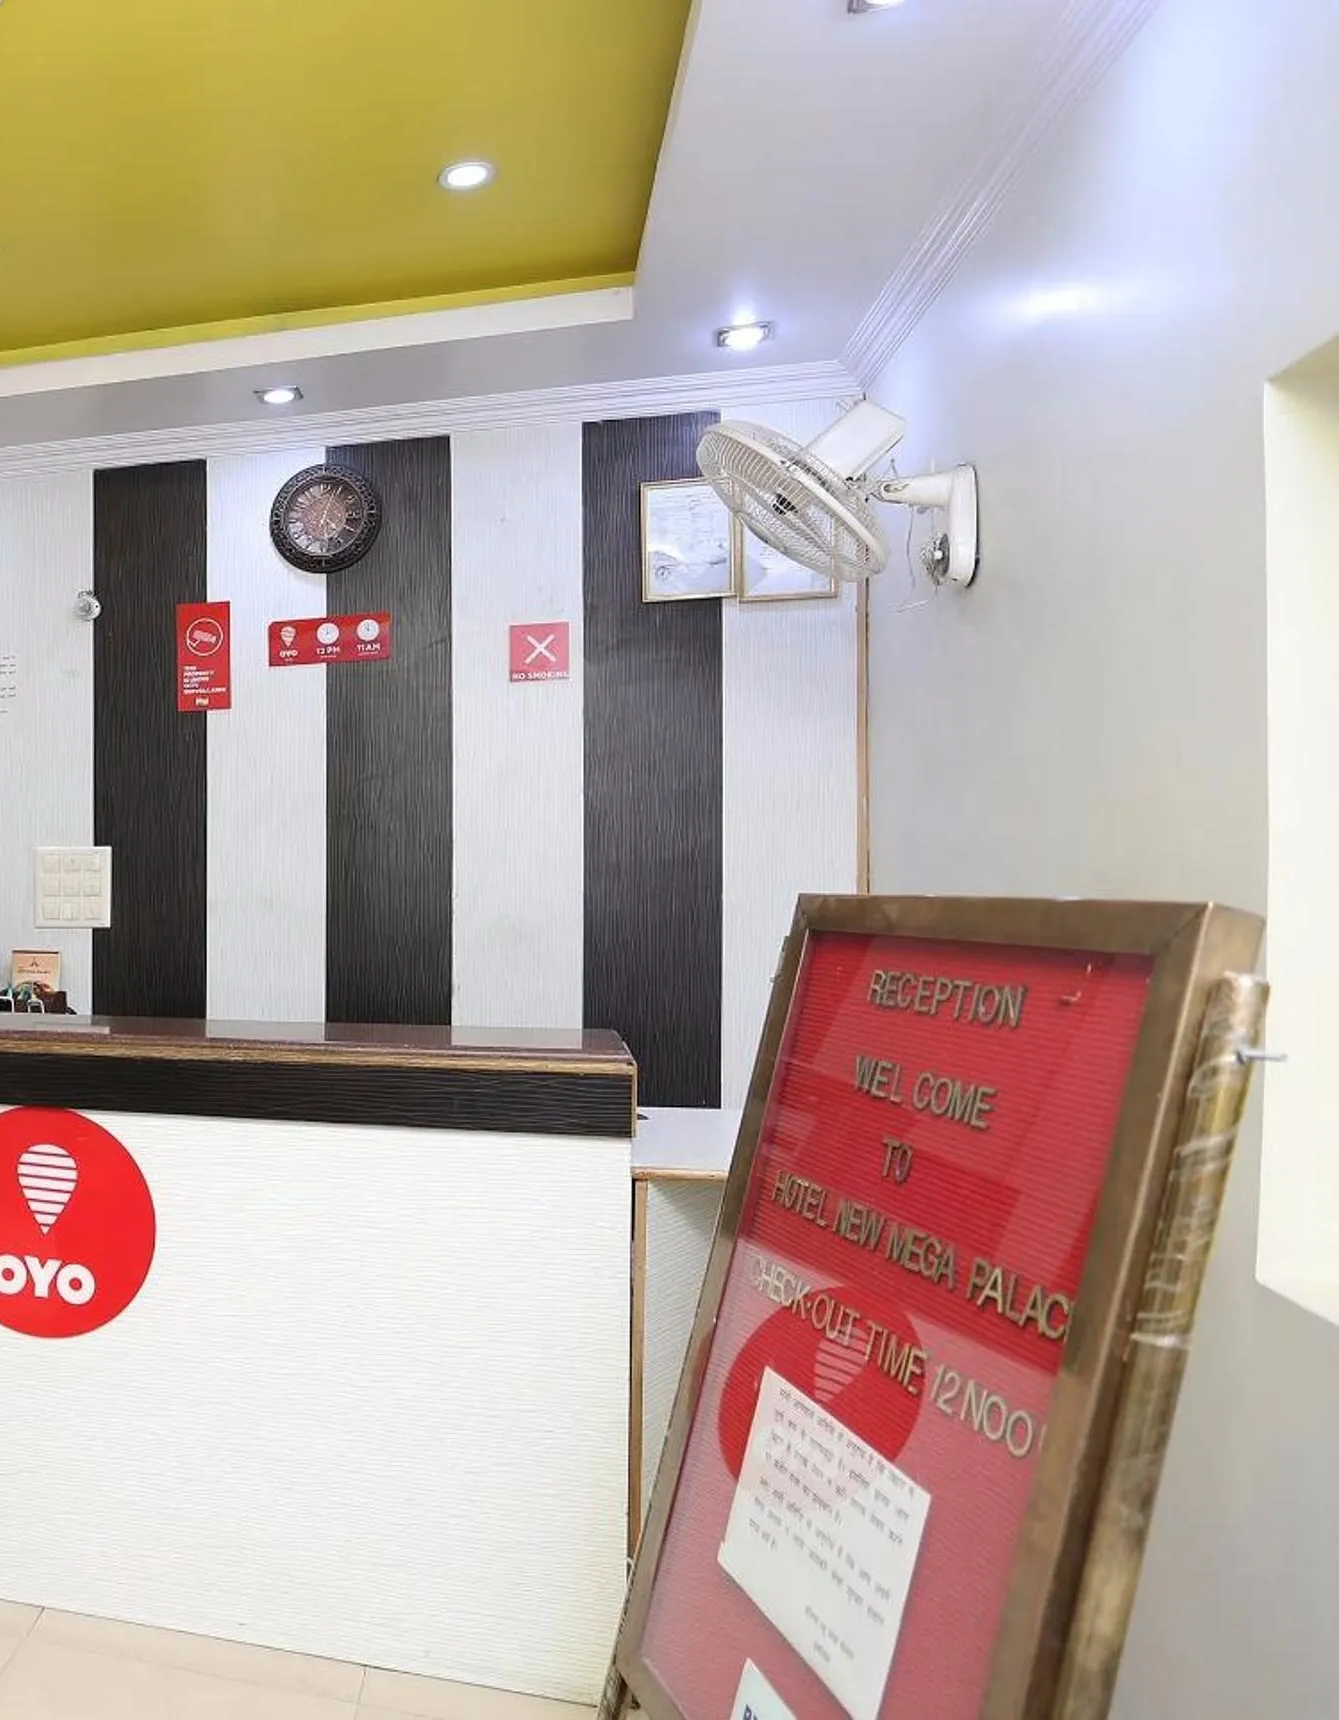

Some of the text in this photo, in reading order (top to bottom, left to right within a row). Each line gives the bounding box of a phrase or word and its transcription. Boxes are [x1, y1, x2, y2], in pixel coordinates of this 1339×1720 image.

[279, 649, 298, 658] OYO
[867, 968, 1028, 1028] RECEPTION
[880, 1136, 914, 1185] TO
[771, 1169, 830, 1227] HOTEL
[832, 1197, 888, 1252] NEW
[884, 1222, 958, 1290] MEGA
[863, 1320, 928, 1395] TIME
[960, 1379, 1047, 1458] NOO
